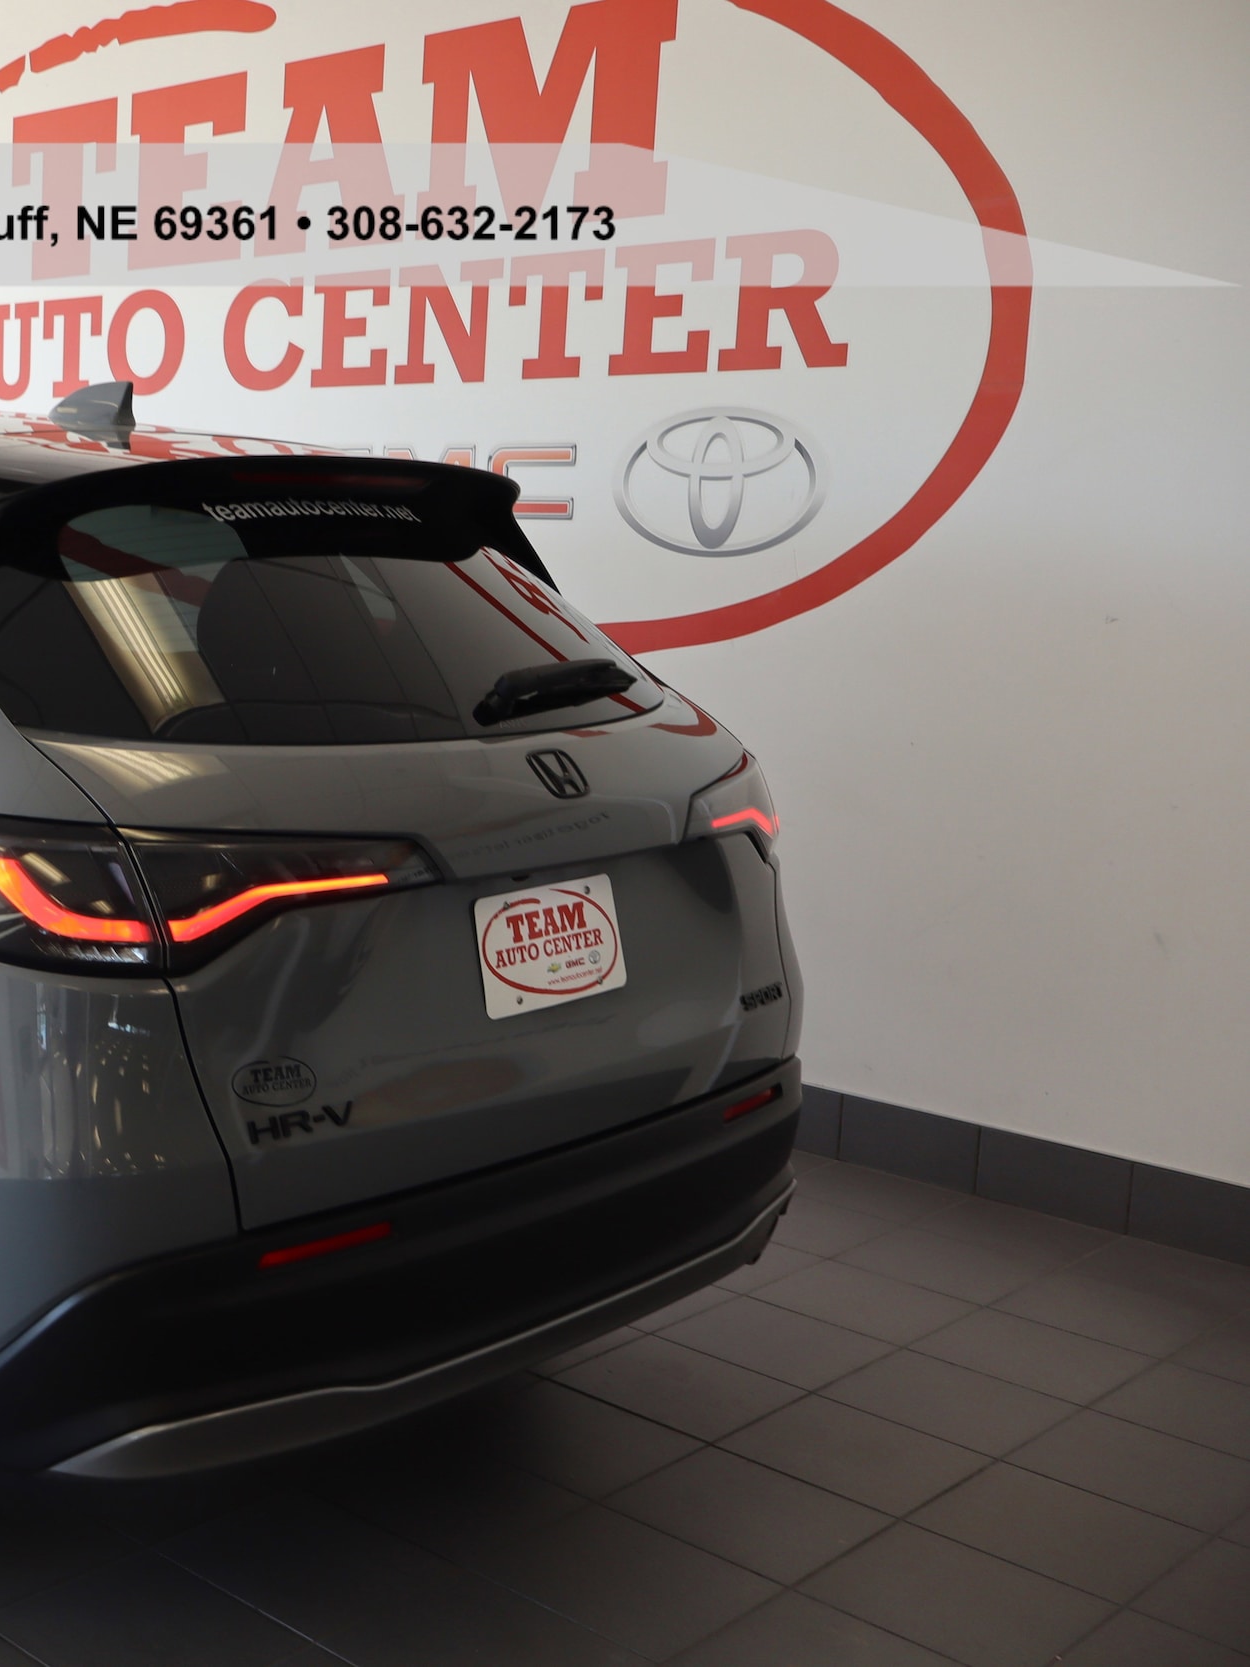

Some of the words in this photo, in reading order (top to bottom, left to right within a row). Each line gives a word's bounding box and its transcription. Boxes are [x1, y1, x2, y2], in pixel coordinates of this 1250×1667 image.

[11, 0, 678, 281] TEAM
[223, 228, 848, 393] CENTER
[202, 498, 422, 523] teamautocenter.net
[506, 901, 587, 944] TEAM
[495, 943, 540, 970] AUTO
[543, 928, 604, 957] CENTER
[242, 1083, 270, 1096] AUTO
[272, 1078, 312, 1092] CENTER
[250, 1064, 302, 1083] TEAM
[247, 1100, 353, 1145] HR-V
